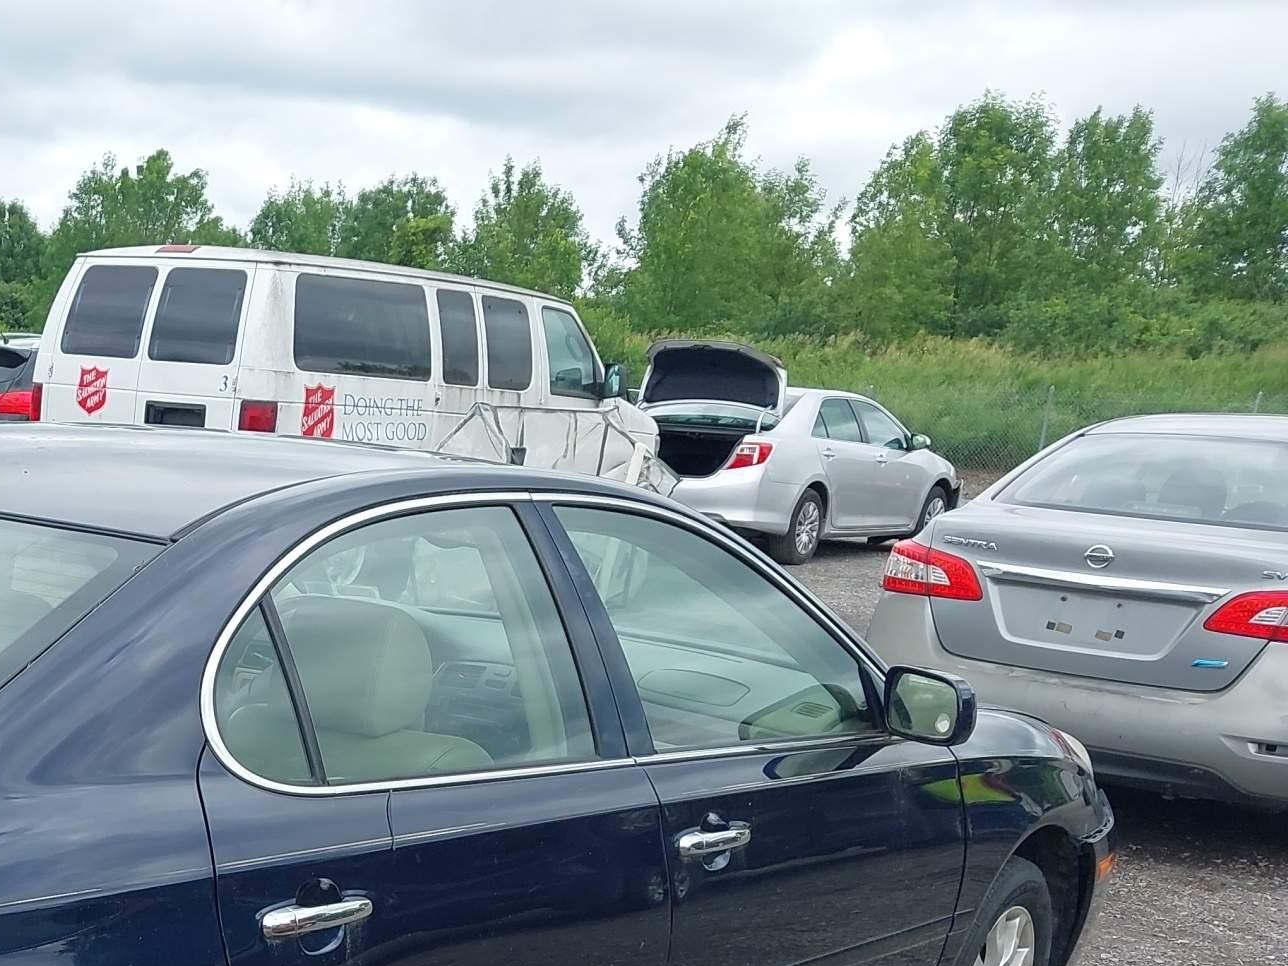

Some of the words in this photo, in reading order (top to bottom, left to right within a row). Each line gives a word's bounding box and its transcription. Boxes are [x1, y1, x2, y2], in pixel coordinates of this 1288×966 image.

[83, 369, 97, 385] THE
[219, 375, 228, 392] 3
[86, 390, 104, 409] ARMY
[309, 389, 322, 408] THE
[343, 393, 393, 416] DOING
[398, 399, 423, 417] THE
[342, 421, 382, 441] MOST
[385, 422, 427, 441] GOOD
